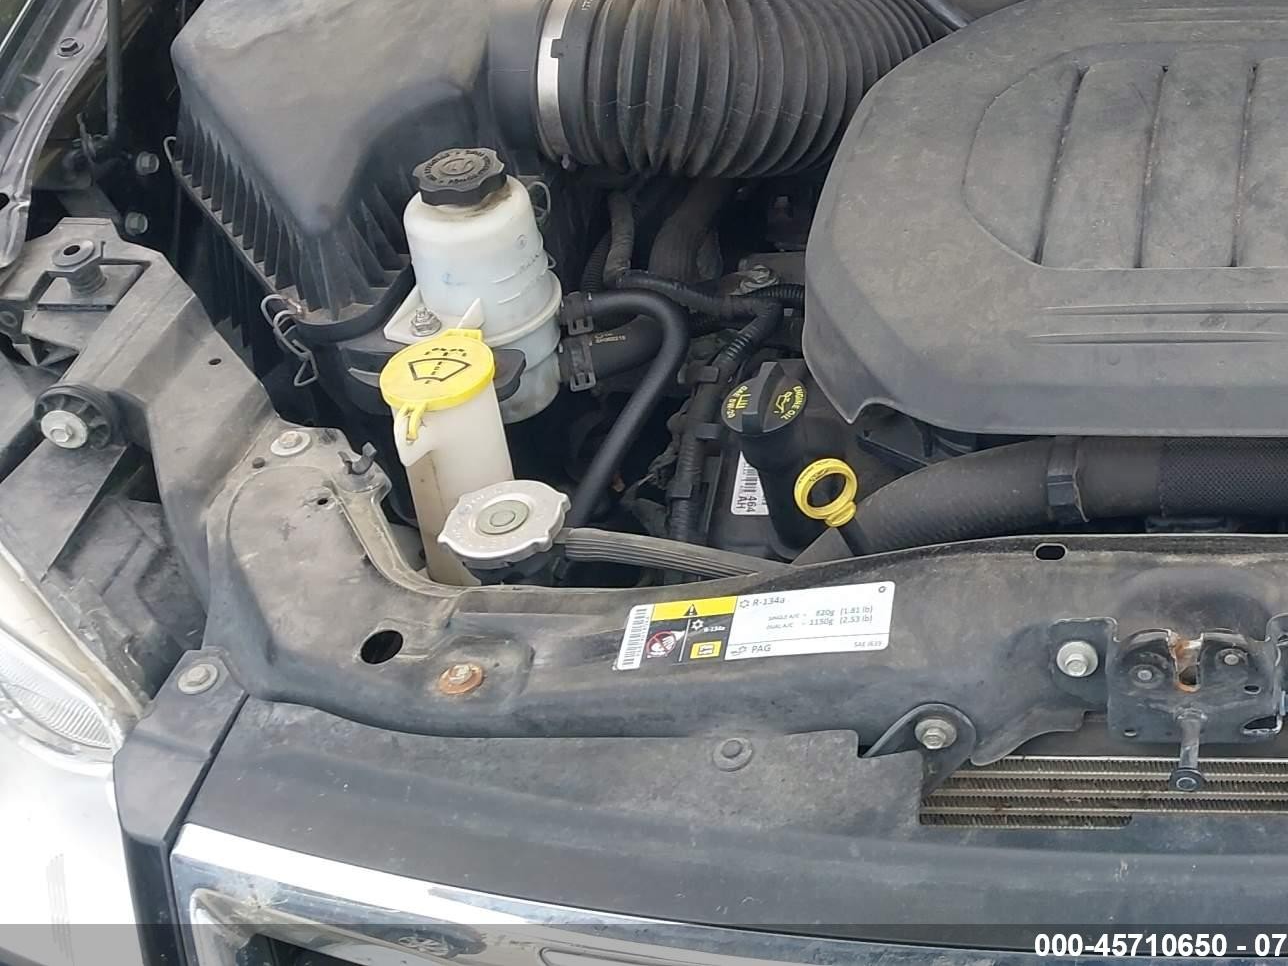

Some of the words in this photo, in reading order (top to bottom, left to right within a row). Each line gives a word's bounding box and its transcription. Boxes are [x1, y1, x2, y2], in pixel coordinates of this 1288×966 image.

[792, 385, 804, 410] ENGINE
[781, 409, 796, 420] OIL
[735, 496, 747, 509] AH
[746, 496, 757, 512] 464
[752, 598, 786, 607] R-134a
[751, 645, 772, 654] PAG
